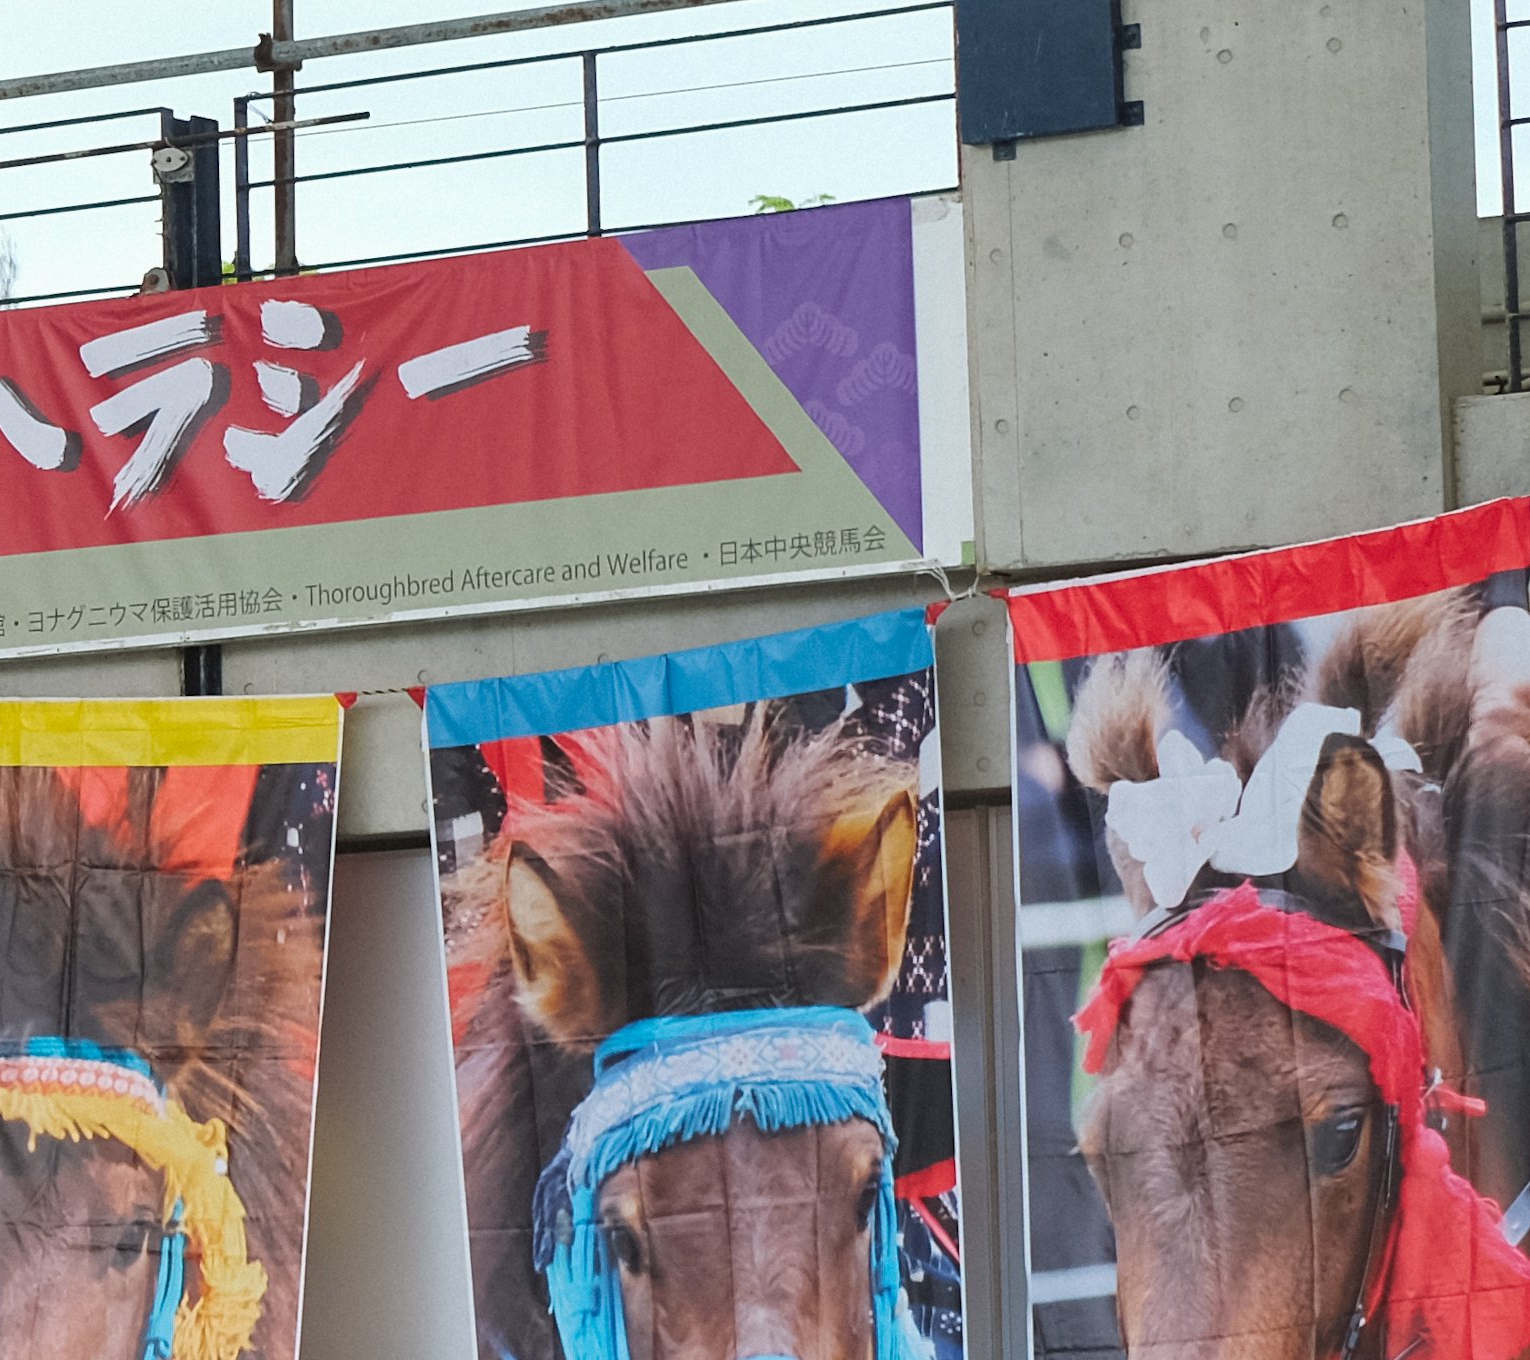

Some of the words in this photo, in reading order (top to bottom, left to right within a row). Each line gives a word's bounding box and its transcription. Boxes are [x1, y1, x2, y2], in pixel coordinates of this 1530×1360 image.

[304, 571, 455, 608] Thoroughbred
[460, 562, 556, 591] Aftercare
[561, 555, 602, 582] and
[607, 547, 689, 577] Welfare
